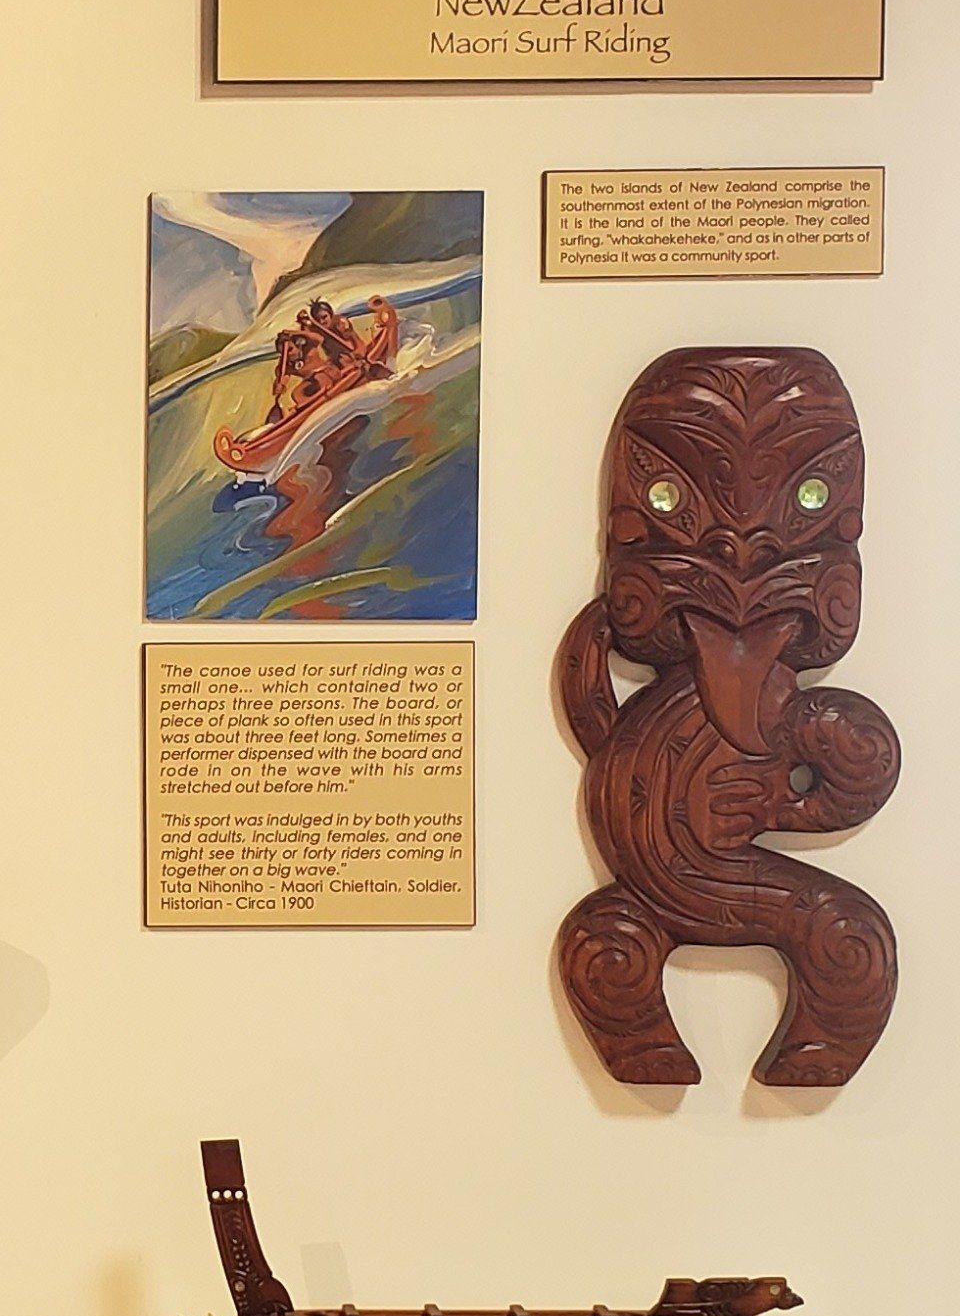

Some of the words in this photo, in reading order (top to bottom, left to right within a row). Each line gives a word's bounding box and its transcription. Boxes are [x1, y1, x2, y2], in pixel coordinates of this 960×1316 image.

[429, 29, 508, 54] Maori
[514, 23, 577, 54] Surf
[584, 23, 671, 64] Riding
[560, 182, 583, 195] The
[590, 182, 614, 195] two
[620, 181, 663, 194] islands
[668, 180, 683, 194] of
[689, 181, 719, 193] New
[725, 180, 778, 193] Zealand
[784, 179, 843, 194] comprise
[849, 179, 871, 192] the
[560, 199, 645, 212] southernmost
[648, 198, 689, 211] extent
[692, 197, 707, 210] of
[710, 198, 732, 210] the
[736, 197, 803, 212] Polynesian
[806, 196, 870, 211] migration.
[160, 663, 193, 678] "The
[198, 665, 252, 678] canoe
[257, 663, 297, 678] used
[301, 663, 324, 677] for
[328, 662, 358, 677] surf
[361, 662, 408, 679] riding
[413, 665, 446, 676] was
[450, 664, 462, 676] a
[159, 696, 226, 714] perhaps
[232, 696, 274, 711] three
[278, 698, 345, 713] persons.
[352, 696, 380, 710] The
[445, 698, 464, 710] or
[159, 763, 199, 777] rode
[207, 763, 222, 777] in
[230, 766, 252, 777] on
[260, 763, 288, 777] the
[296, 765, 342, 777] wave
[350, 762, 384, 777] with
[392, 762, 415, 776] his
[422, 764, 463, 776] arms
[160, 829, 192, 844] and
[251, 829, 321, 846] including
[395, 829, 428, 843] and
[432, 831, 463, 843] one
[159, 880, 192, 894] Tuta
[197, 879, 264, 893] Nihoniho
[280, 879, 323, 893] Maori
[160, 896, 223, 911] Historian
[234, 896, 276, 910] Circa
[280, 895, 315, 910] 1900
